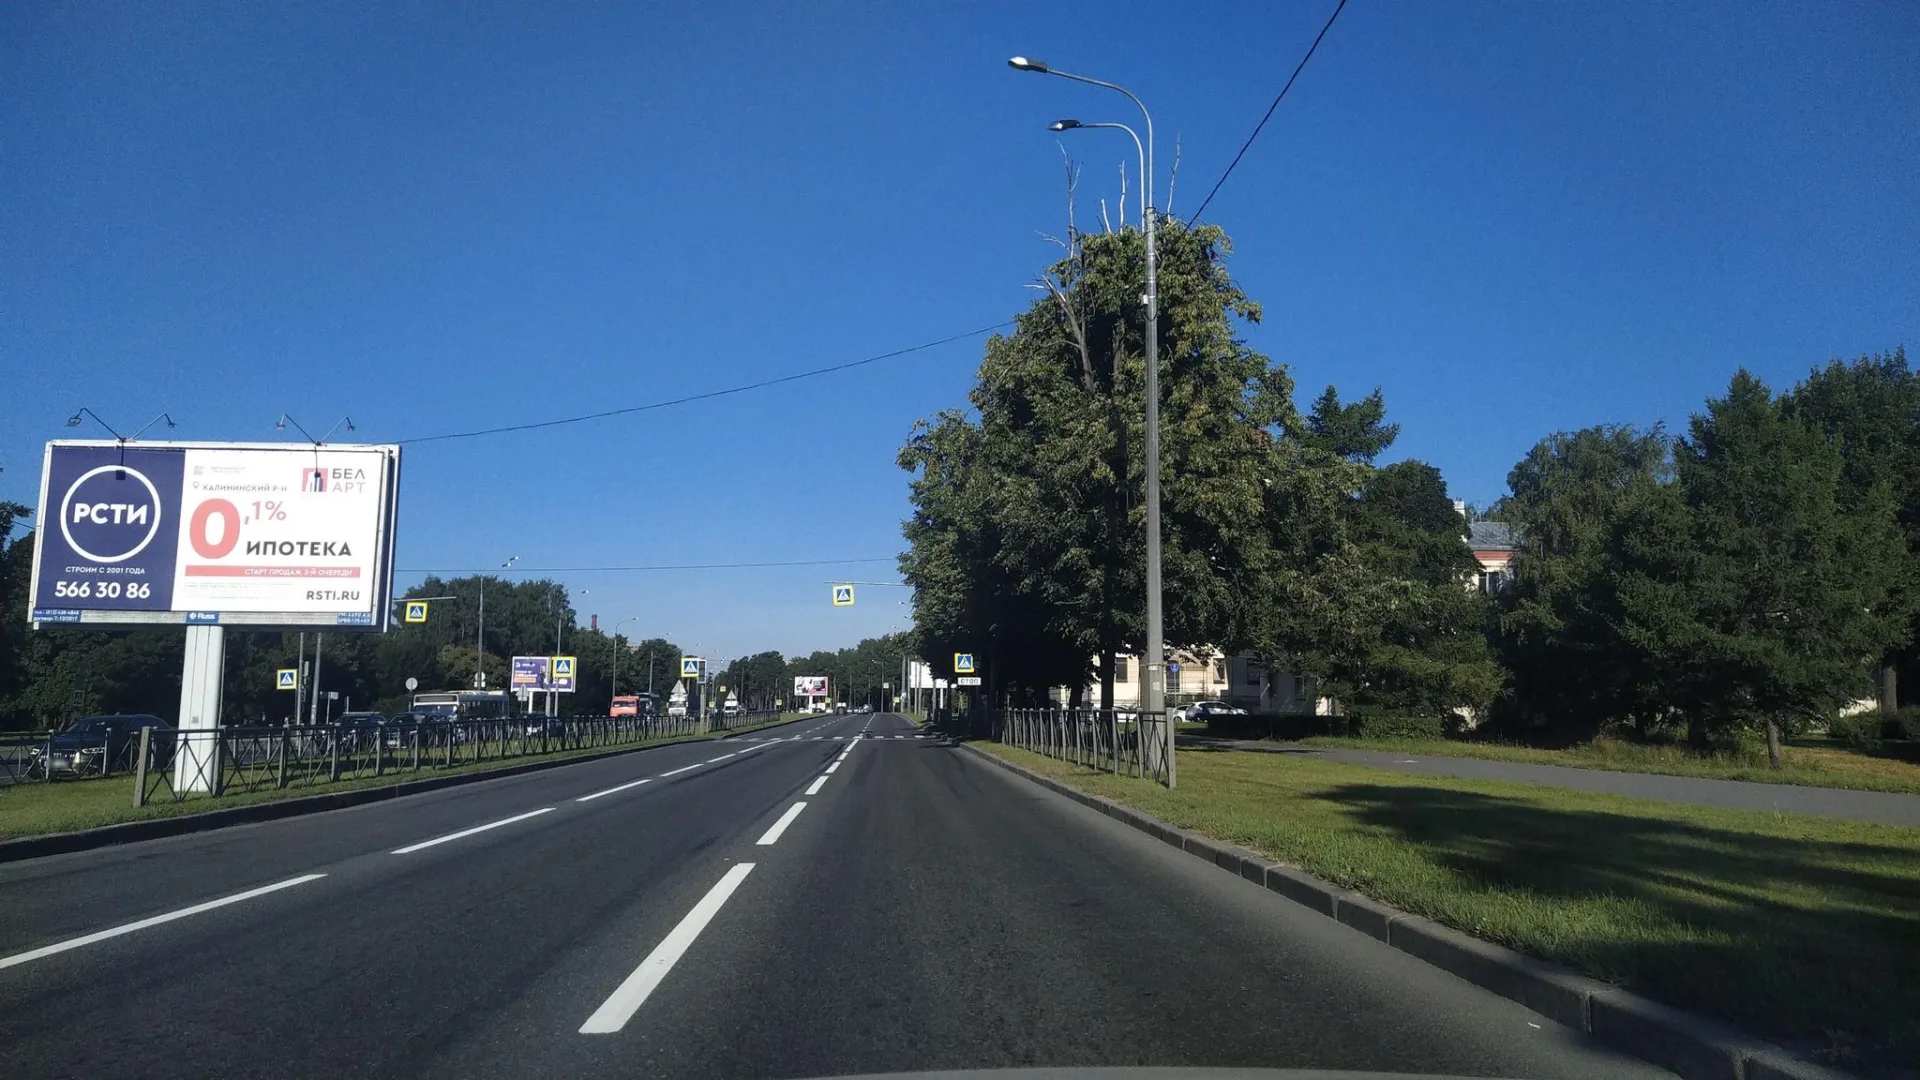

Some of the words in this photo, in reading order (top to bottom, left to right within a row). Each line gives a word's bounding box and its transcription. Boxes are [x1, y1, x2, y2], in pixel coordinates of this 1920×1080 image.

[332, 468, 366, 480] БЕЛ
[202, 483, 270, 492] КАЛИНИНСКИЙ
[332, 482, 366, 493] АРТ
[73, 503, 148, 525] РСТИ
[246, 541, 352, 556] ИПОТЕКА
[65, 565, 97, 574] СТРОИМ
[99, 566, 105, 574] С
[106, 566, 124, 574] 2001
[125, 567, 146, 575] ГОДА
[244, 568, 268, 576] СТАРТ
[269, 568, 302, 576] ПРОДАЖ
[318, 569, 353, 577] ОЧЕРЕДИ
[54, 581, 91, 598] 566
[95, 582, 121, 599] 30
[126, 582, 151, 600] 86
[306, 590, 360, 601] RSTI.RU
